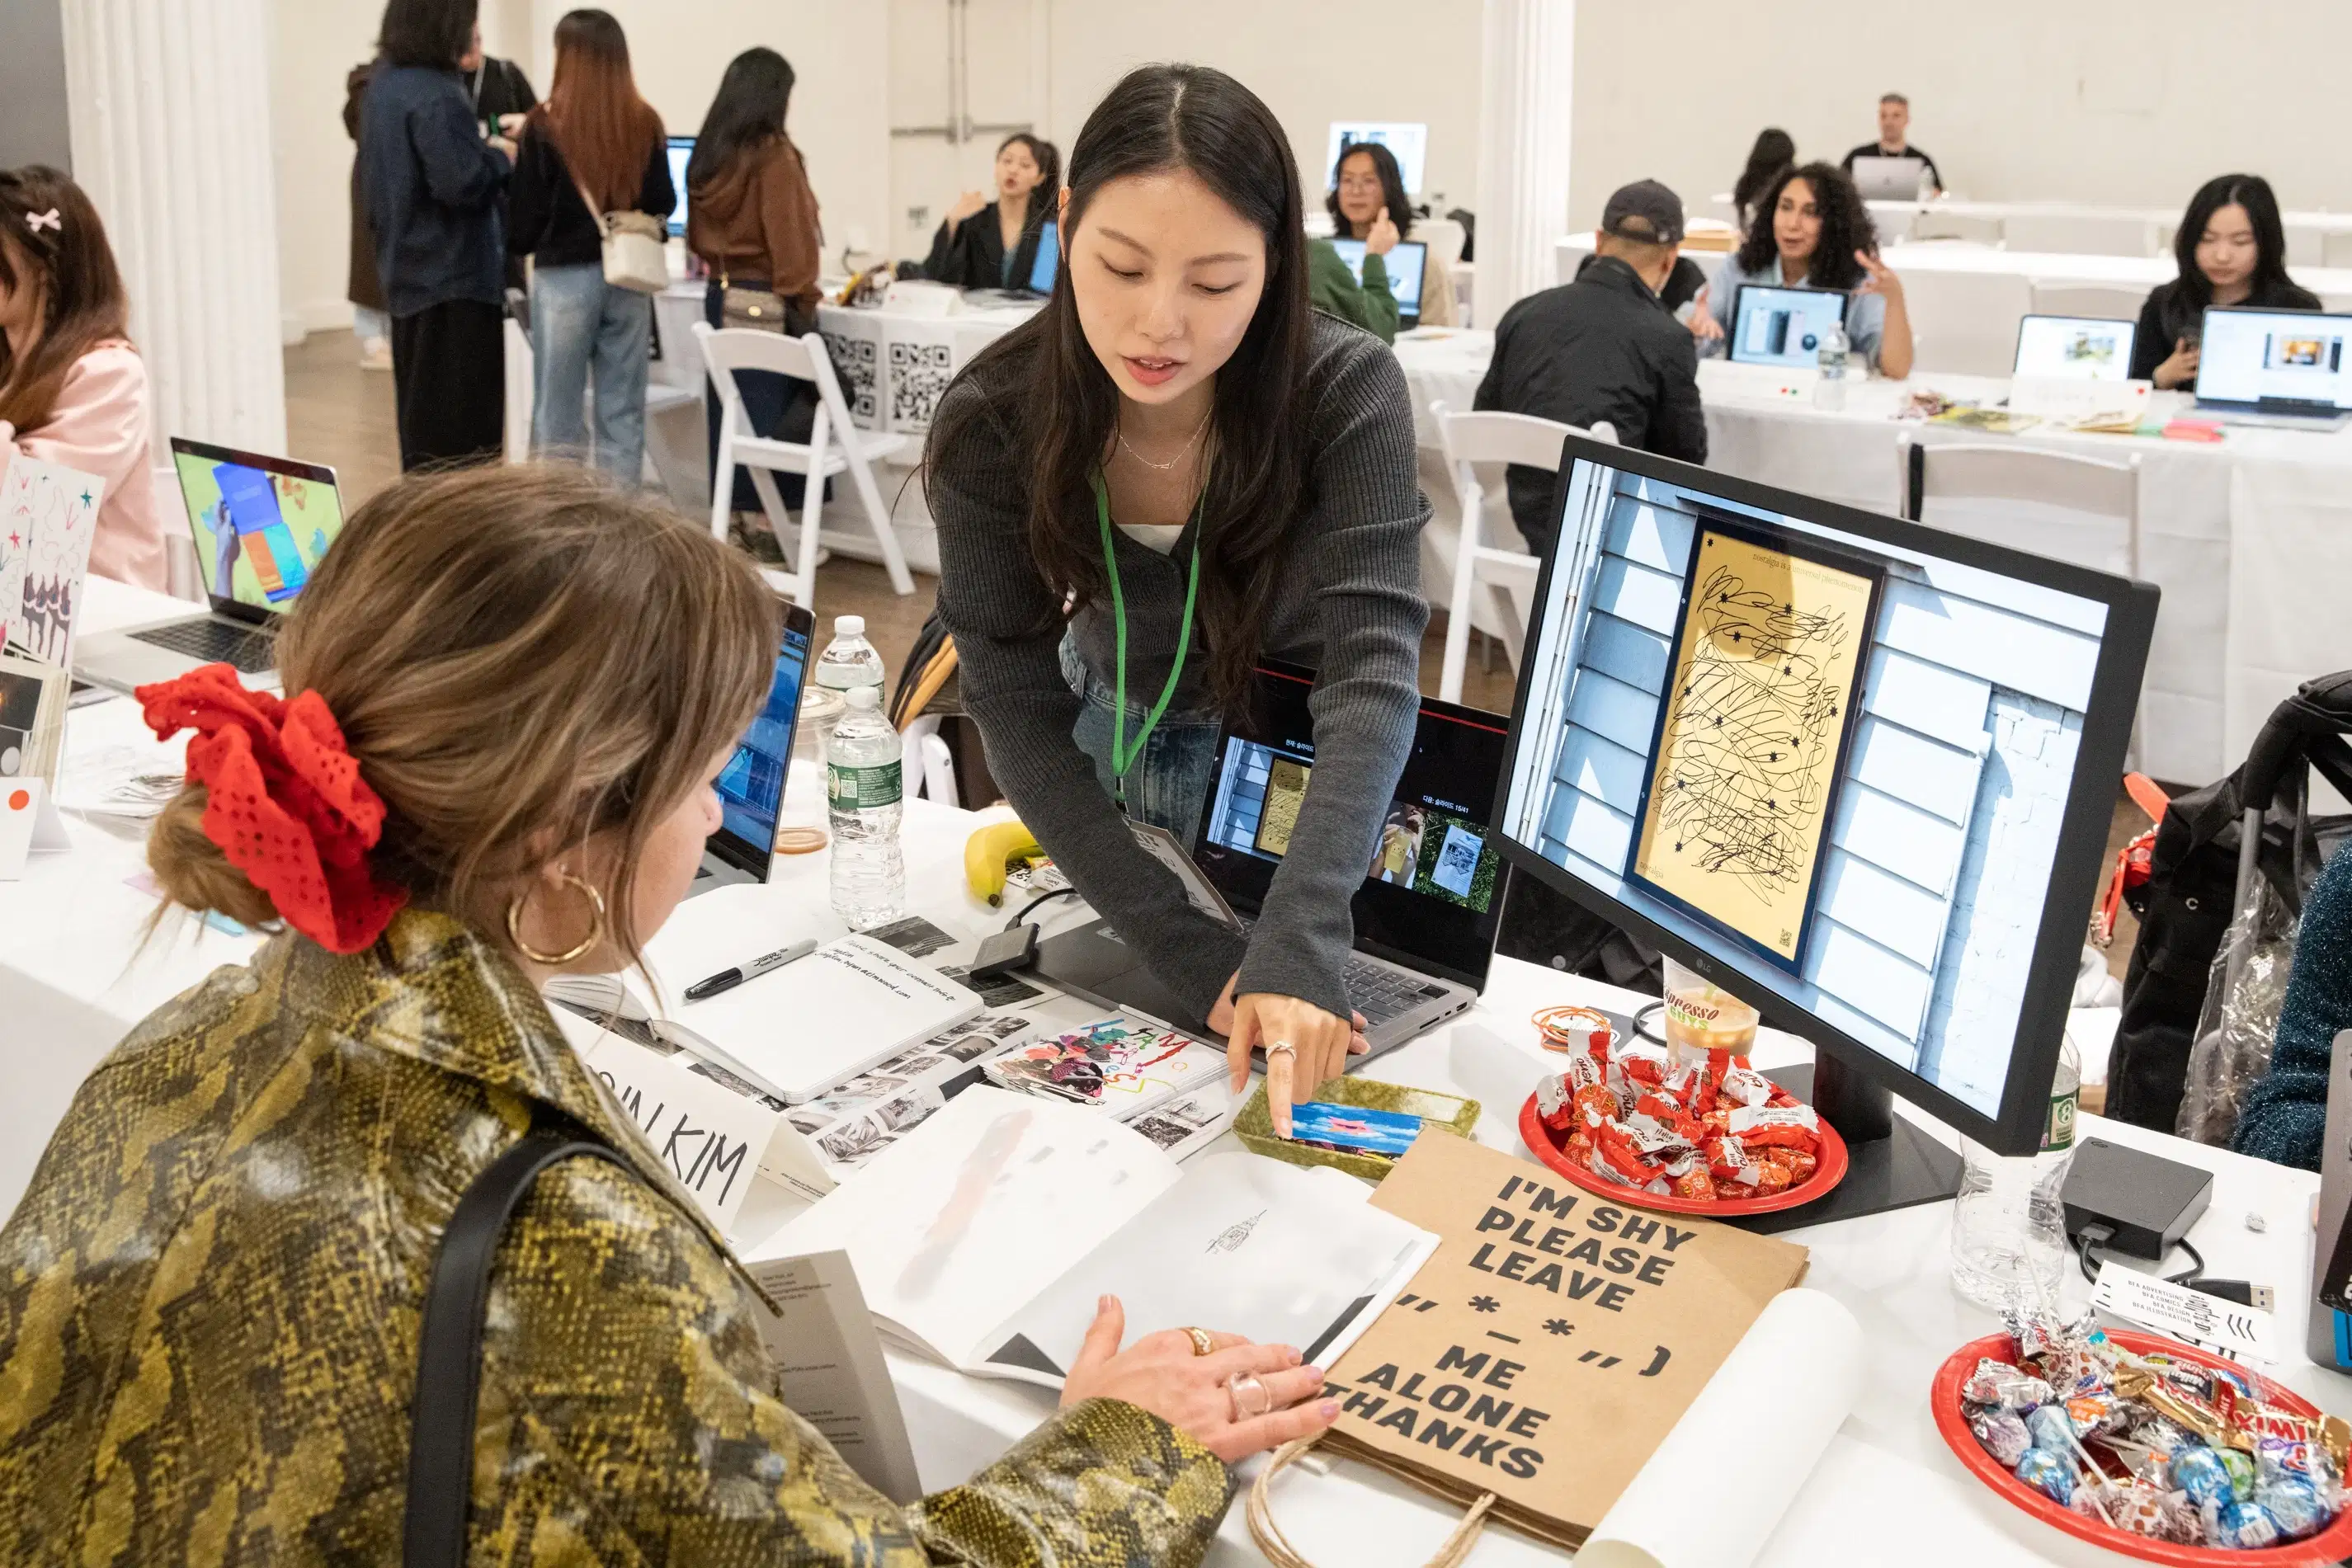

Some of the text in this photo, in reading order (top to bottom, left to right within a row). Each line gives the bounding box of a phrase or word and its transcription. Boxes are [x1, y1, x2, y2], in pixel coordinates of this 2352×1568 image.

[1752, 553, 1779, 569] nostalgia
[1780, 561, 1786, 570] is
[1792, 566, 1821, 580] universal
[1822, 573, 1864, 595] phenomenon
[1422, 794, 1469, 813] 다음: 슬라이드 15/41
[1665, 989, 1720, 1021] spresso
[1670, 1005, 1709, 1030] GUYS
[662, 1113, 748, 1207] KIM
[1497, 1175, 1697, 1254] I'M SHY
[1476, 1206, 1676, 1287] PLEASE
[1468, 1243, 1636, 1313] LEAVE
[2142, 1284, 2185, 1302] ADVERTISING
[2147, 1305, 2193, 1324] ILLUSTRATION
[2166, 1306, 2191, 1317] DESIGN
[1435, 1345, 1527, 1391] ME
[1355, 1363, 1552, 1441] ALONE
[1320, 1381, 1545, 1480] THANKS
